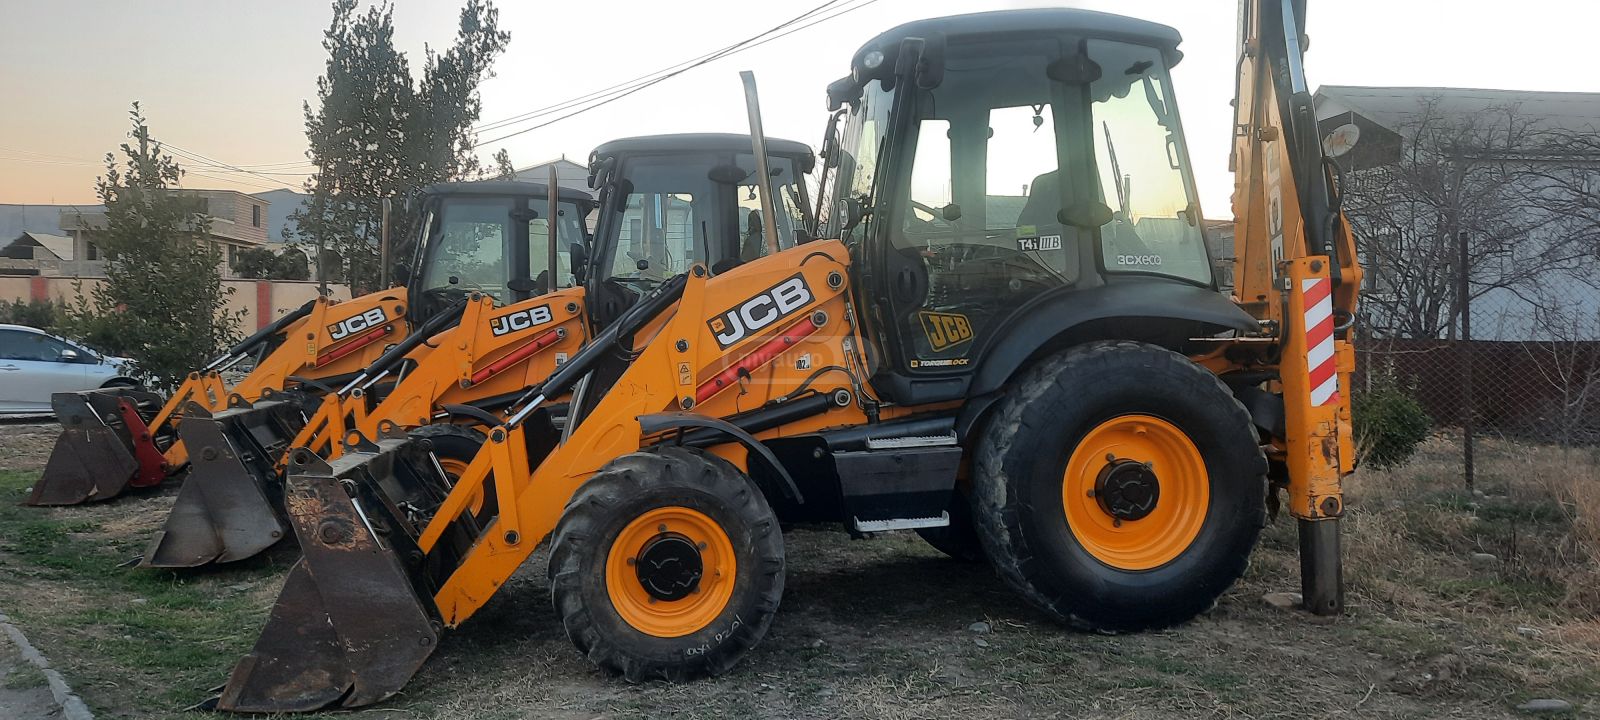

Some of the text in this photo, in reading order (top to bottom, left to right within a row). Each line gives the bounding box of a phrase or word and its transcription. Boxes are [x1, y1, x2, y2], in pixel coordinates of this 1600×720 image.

[1018, 238, 1038, 250] T4i
[331, 308, 386, 339] JCB
[492, 306, 552, 336] JCB
[717, 277, 811, 345] JCB
[928, 315, 970, 347] JCB
